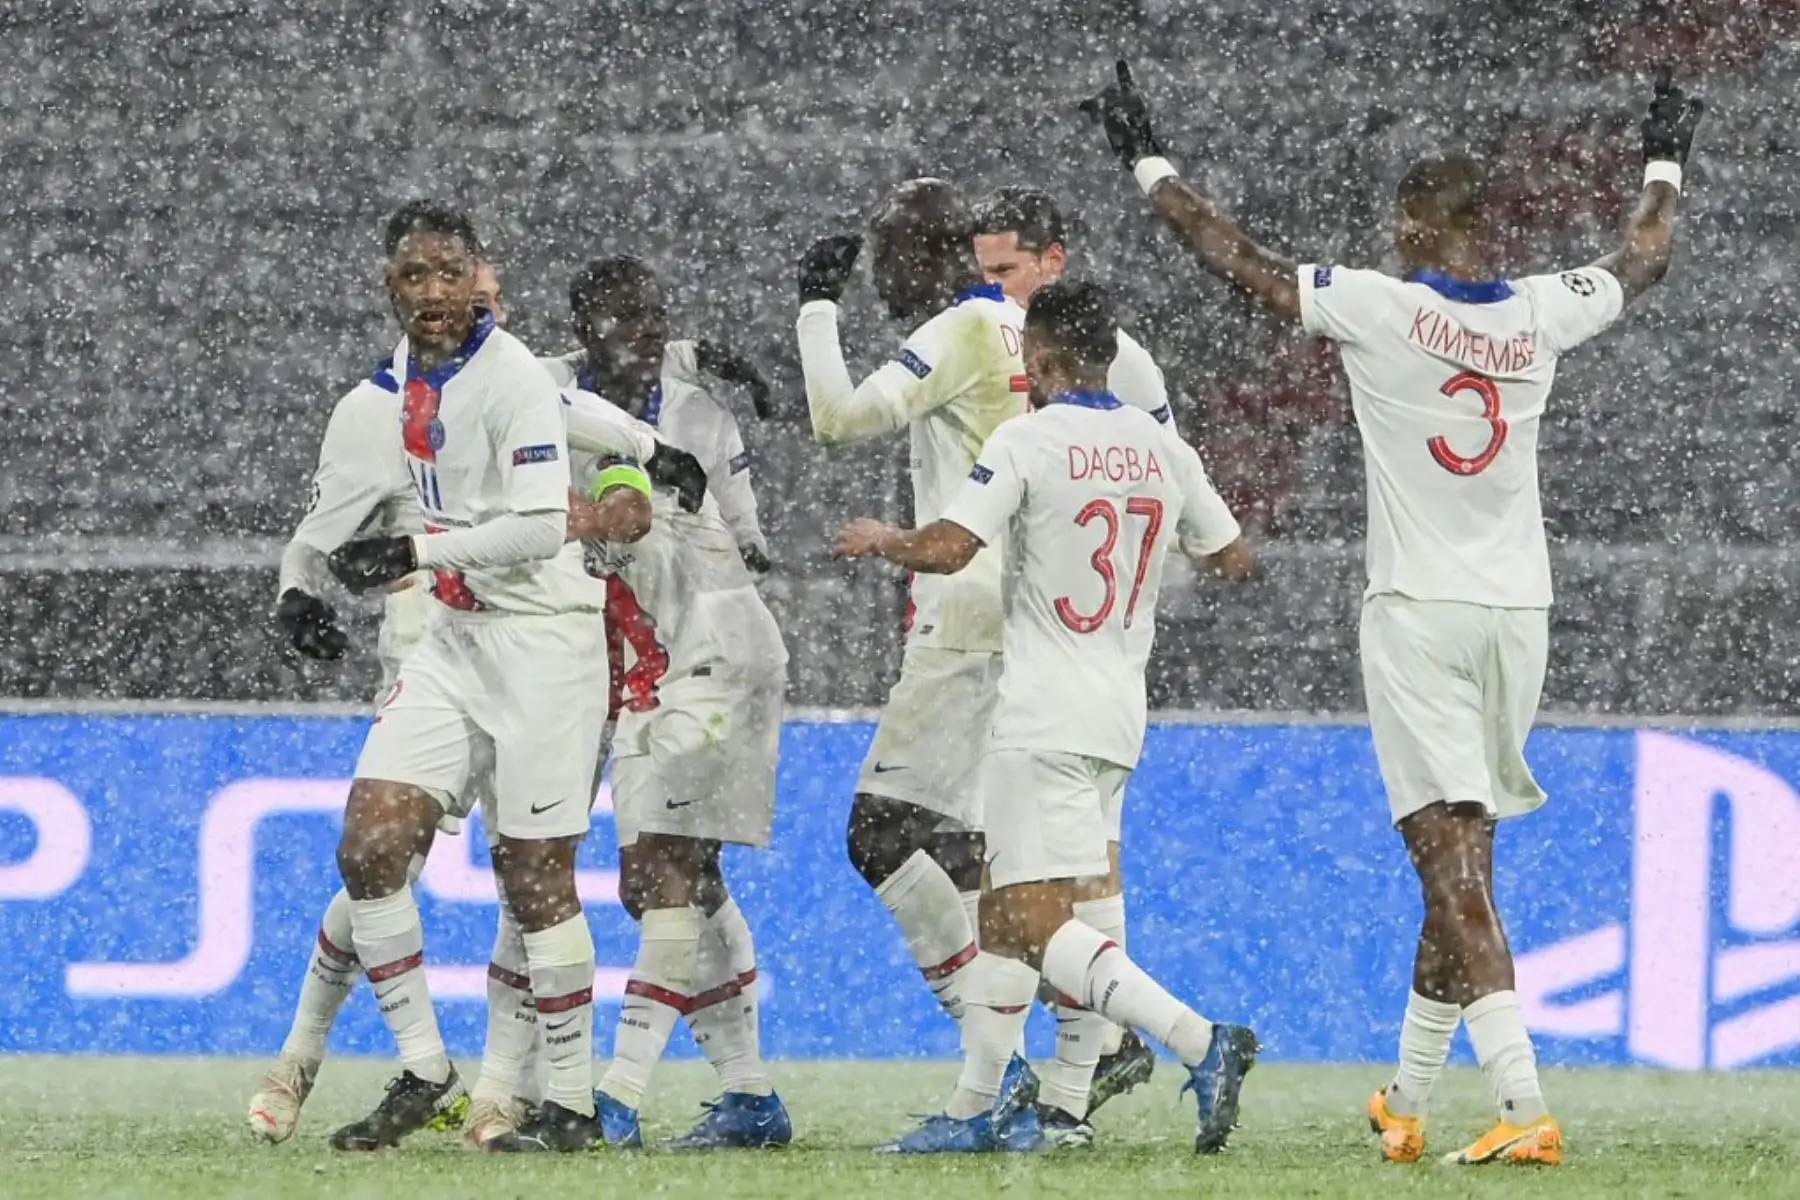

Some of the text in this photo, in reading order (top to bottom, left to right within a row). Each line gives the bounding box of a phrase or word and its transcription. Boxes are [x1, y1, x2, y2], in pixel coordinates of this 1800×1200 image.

[1068, 445, 1164, 482] DAGBA
[1427, 370, 1508, 477] 3
[1054, 497, 1164, 633] 37
